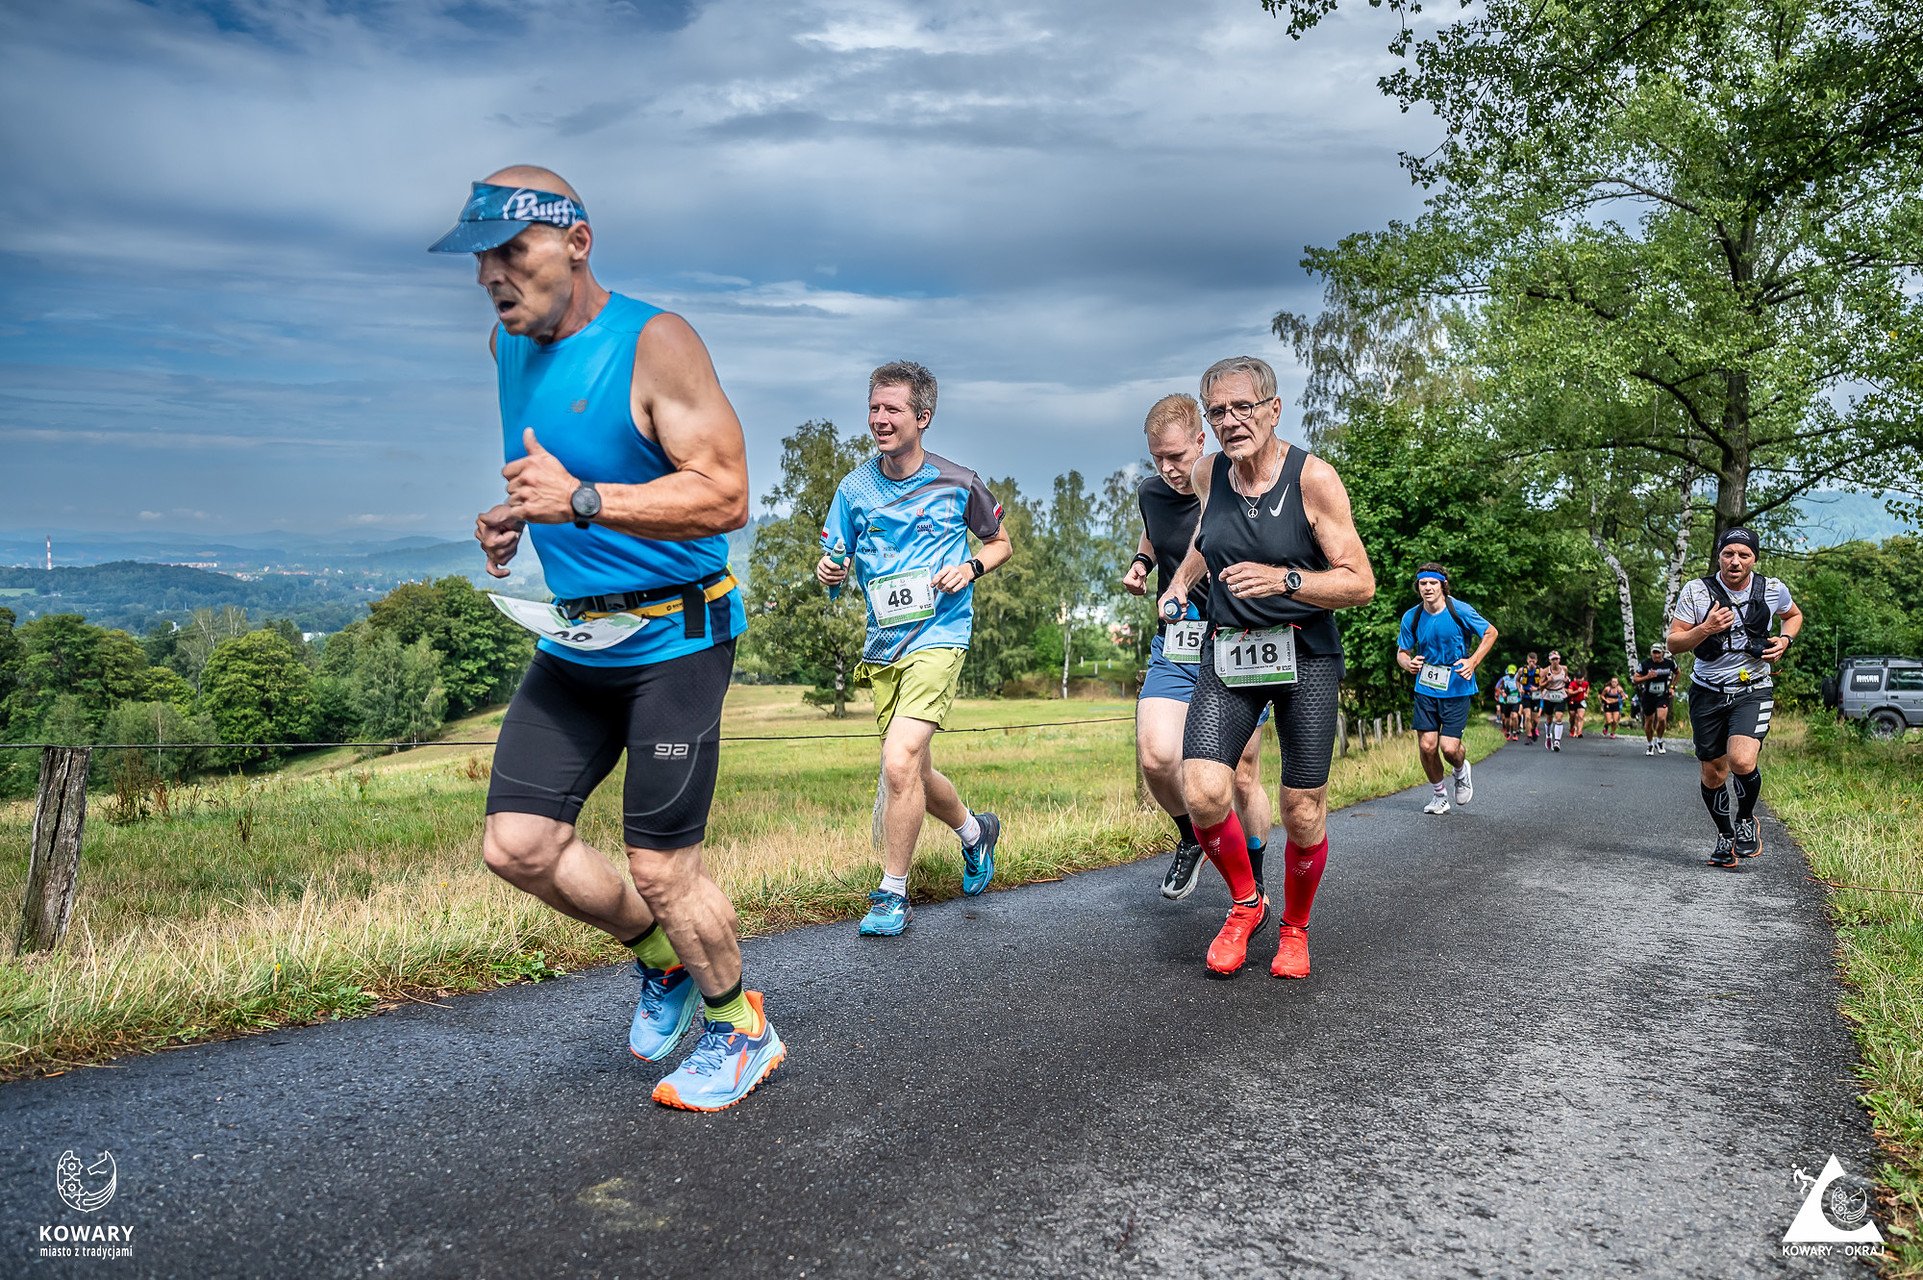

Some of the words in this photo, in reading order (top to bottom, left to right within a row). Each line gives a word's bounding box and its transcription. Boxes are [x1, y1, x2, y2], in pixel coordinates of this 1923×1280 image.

[888, 588, 913, 607] 48
[1175, 630, 1204, 648] 15
[1230, 643, 1279, 666] 118
[1427, 670, 1439, 681] 61
